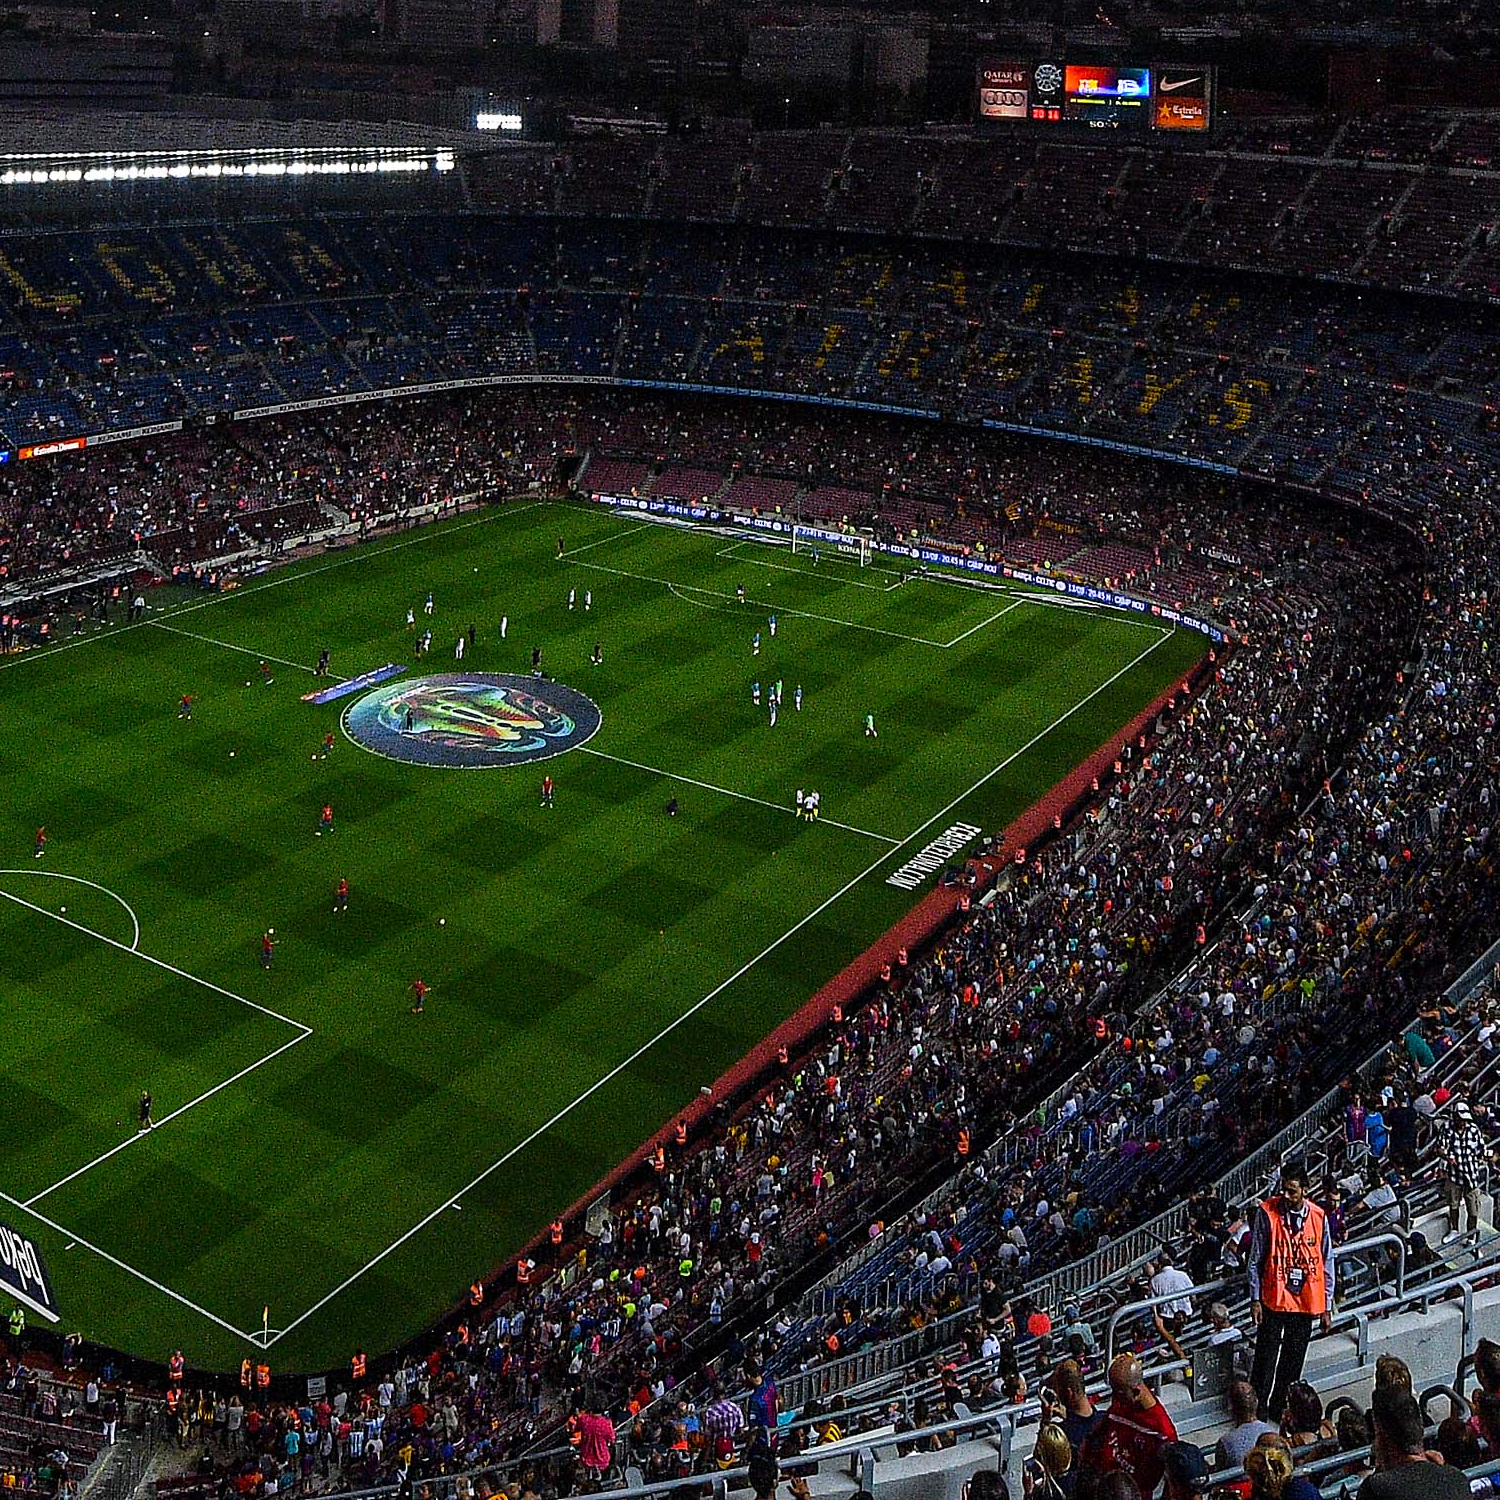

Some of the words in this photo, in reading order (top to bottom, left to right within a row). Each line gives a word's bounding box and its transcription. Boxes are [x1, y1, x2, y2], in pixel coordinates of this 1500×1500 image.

[984, 71, 1012, 80] QATAR
[1172, 105, 1202, 115] Estrella
[922, 551, 939, 561] 13/09
[941, 554, 958, 565] 20.45
[967, 558, 984, 569] CAMP
[984, 564, 998, 574] NOU
[1035, 576, 1056, 588] CELTIC
[1131, 600, 1145, 611] NOU
